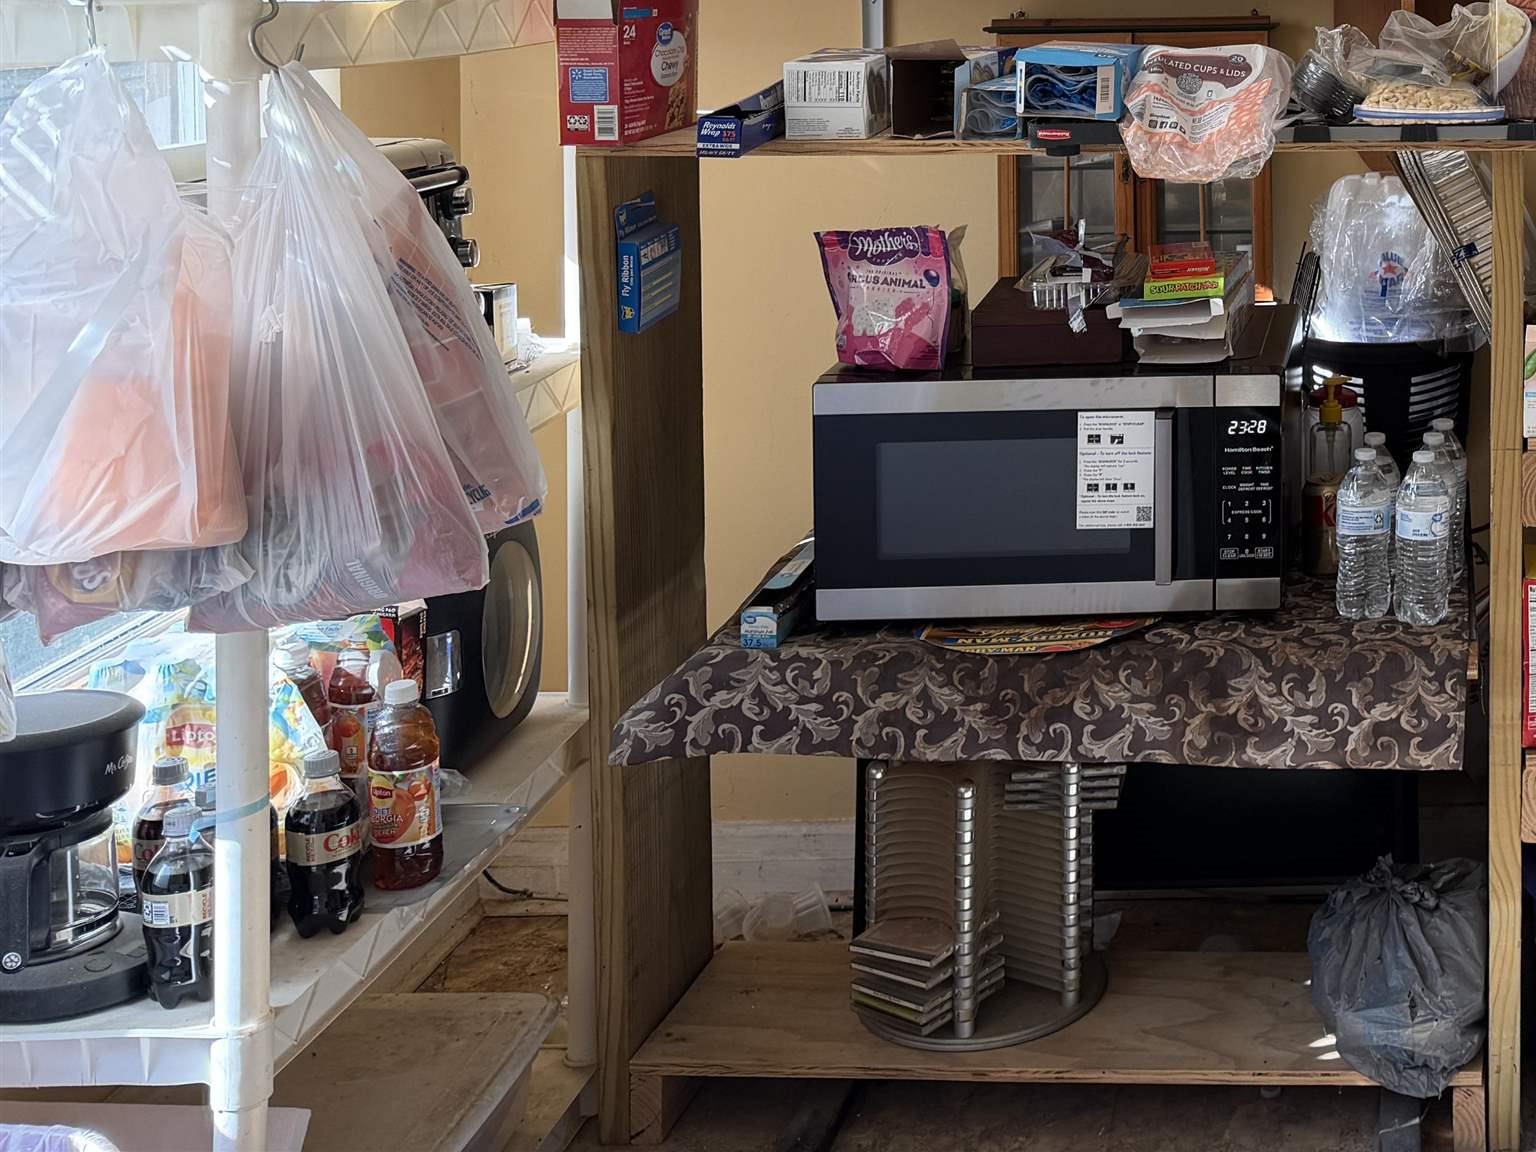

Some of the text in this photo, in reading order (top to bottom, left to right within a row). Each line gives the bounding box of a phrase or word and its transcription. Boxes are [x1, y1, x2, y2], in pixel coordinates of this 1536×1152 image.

[623, 25, 636, 38] 24
[1193, 64, 1217, 74] CUPS
[1225, 69, 1246, 78] LIDS
[701, 128, 720, 136] Wrap
[703, 122, 736, 130] Reynolds
[852, 232, 918, 258] Mother's
[621, 255, 632, 297] Fly Ribbon
[881, 276, 926, 289] ANIMAL
[1150, 285, 1174, 294] SOUR
[1175, 283, 1202, 292] PATCH
[1228, 420, 1267, 435] 23:28
[171, 727, 216, 744] Lipto
[184, 768, 216, 790] DIE
